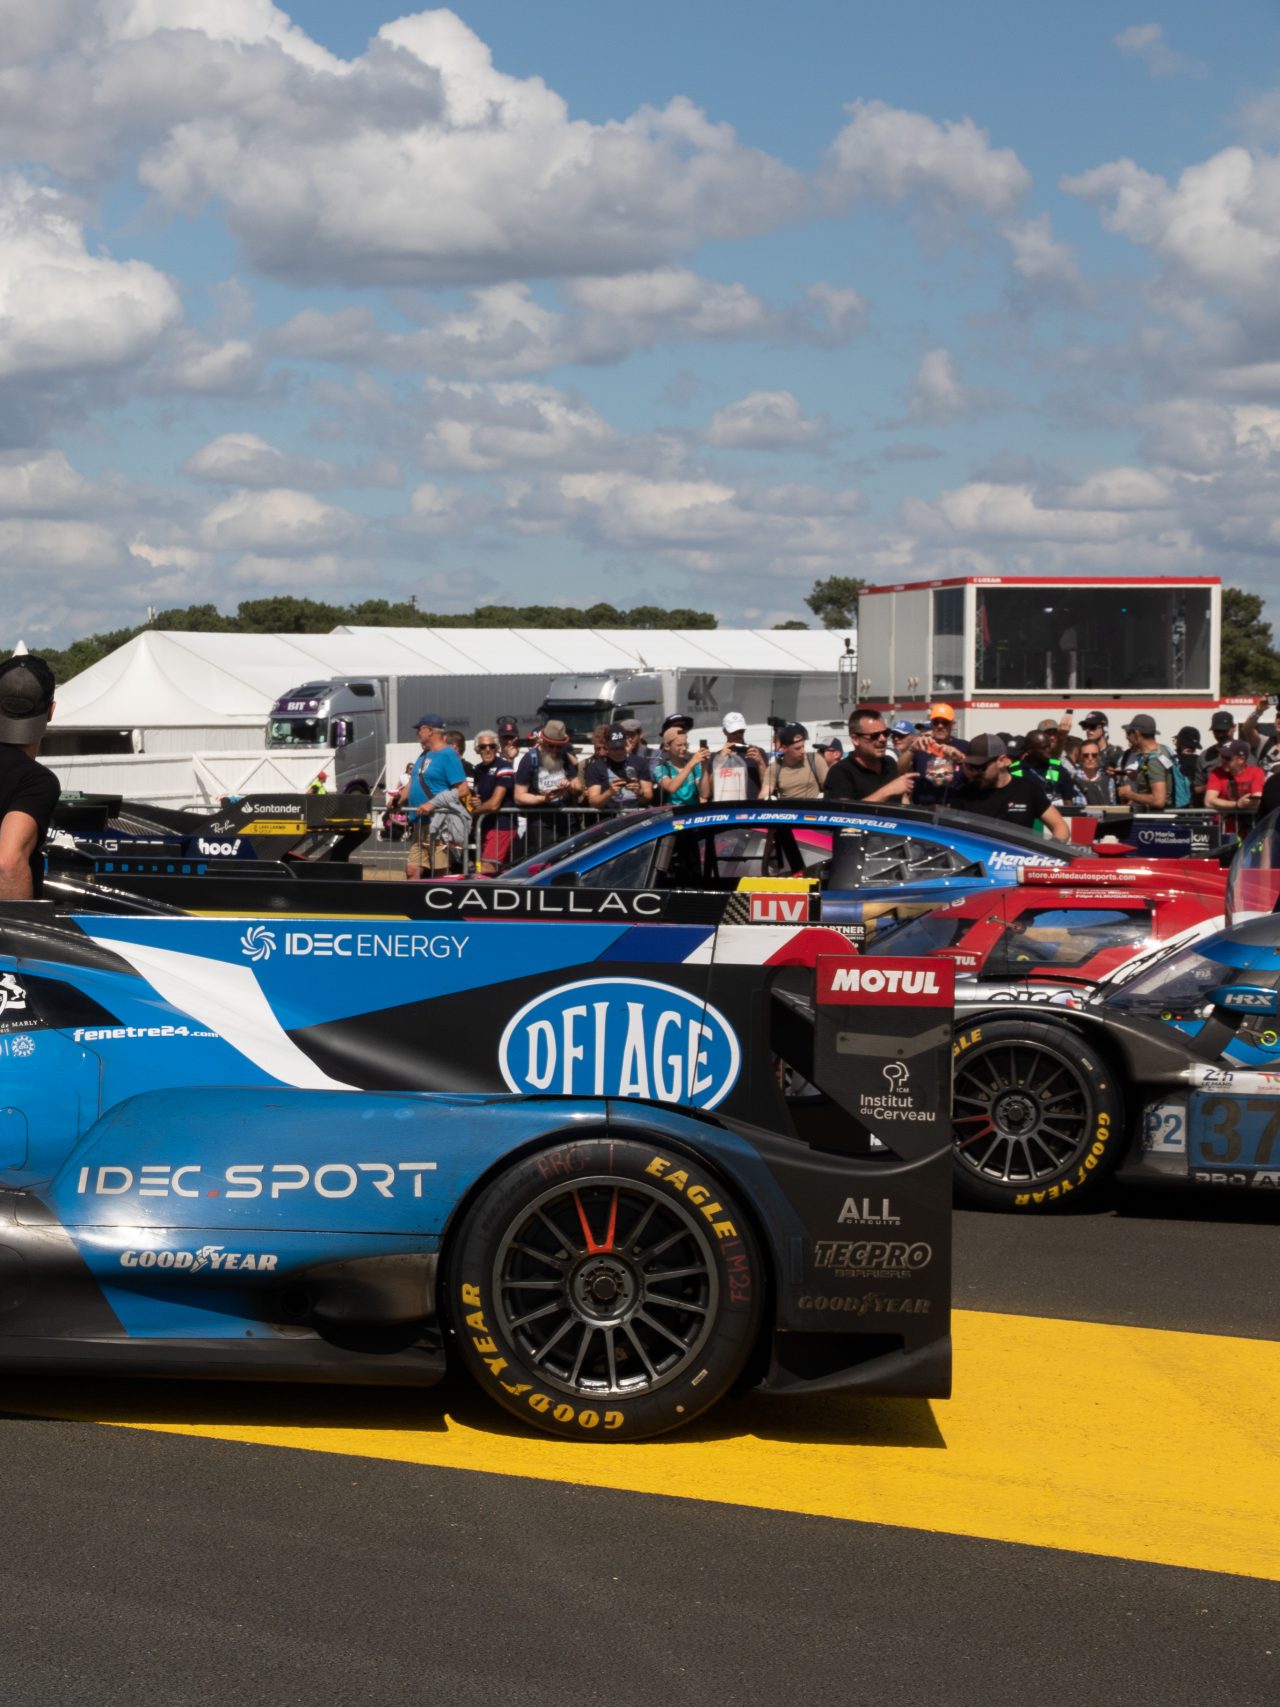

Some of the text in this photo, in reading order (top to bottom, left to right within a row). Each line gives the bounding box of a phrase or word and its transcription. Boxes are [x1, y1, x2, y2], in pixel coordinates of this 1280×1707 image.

[253, 803, 301, 814] Santander
[757, 813, 799, 822] JOHNSON
[424, 887, 662, 915] CADILLAC
[830, 968, 940, 994] MOTUL
[1224, 993, 1273, 1006] HRX
[11, 1019, 39, 1028] MARLY
[860, 1094, 914, 1107] Institut
[860, 1107, 936, 1122] du Cerveau
[1200, 1098, 1280, 1164] 37
[644, 1155, 738, 1240] EAGLE
[837, 1197, 901, 1223] ALL
[120, 1245, 279, 1274] GOODYEAR
[814, 1240, 932, 1270] TECPRO
